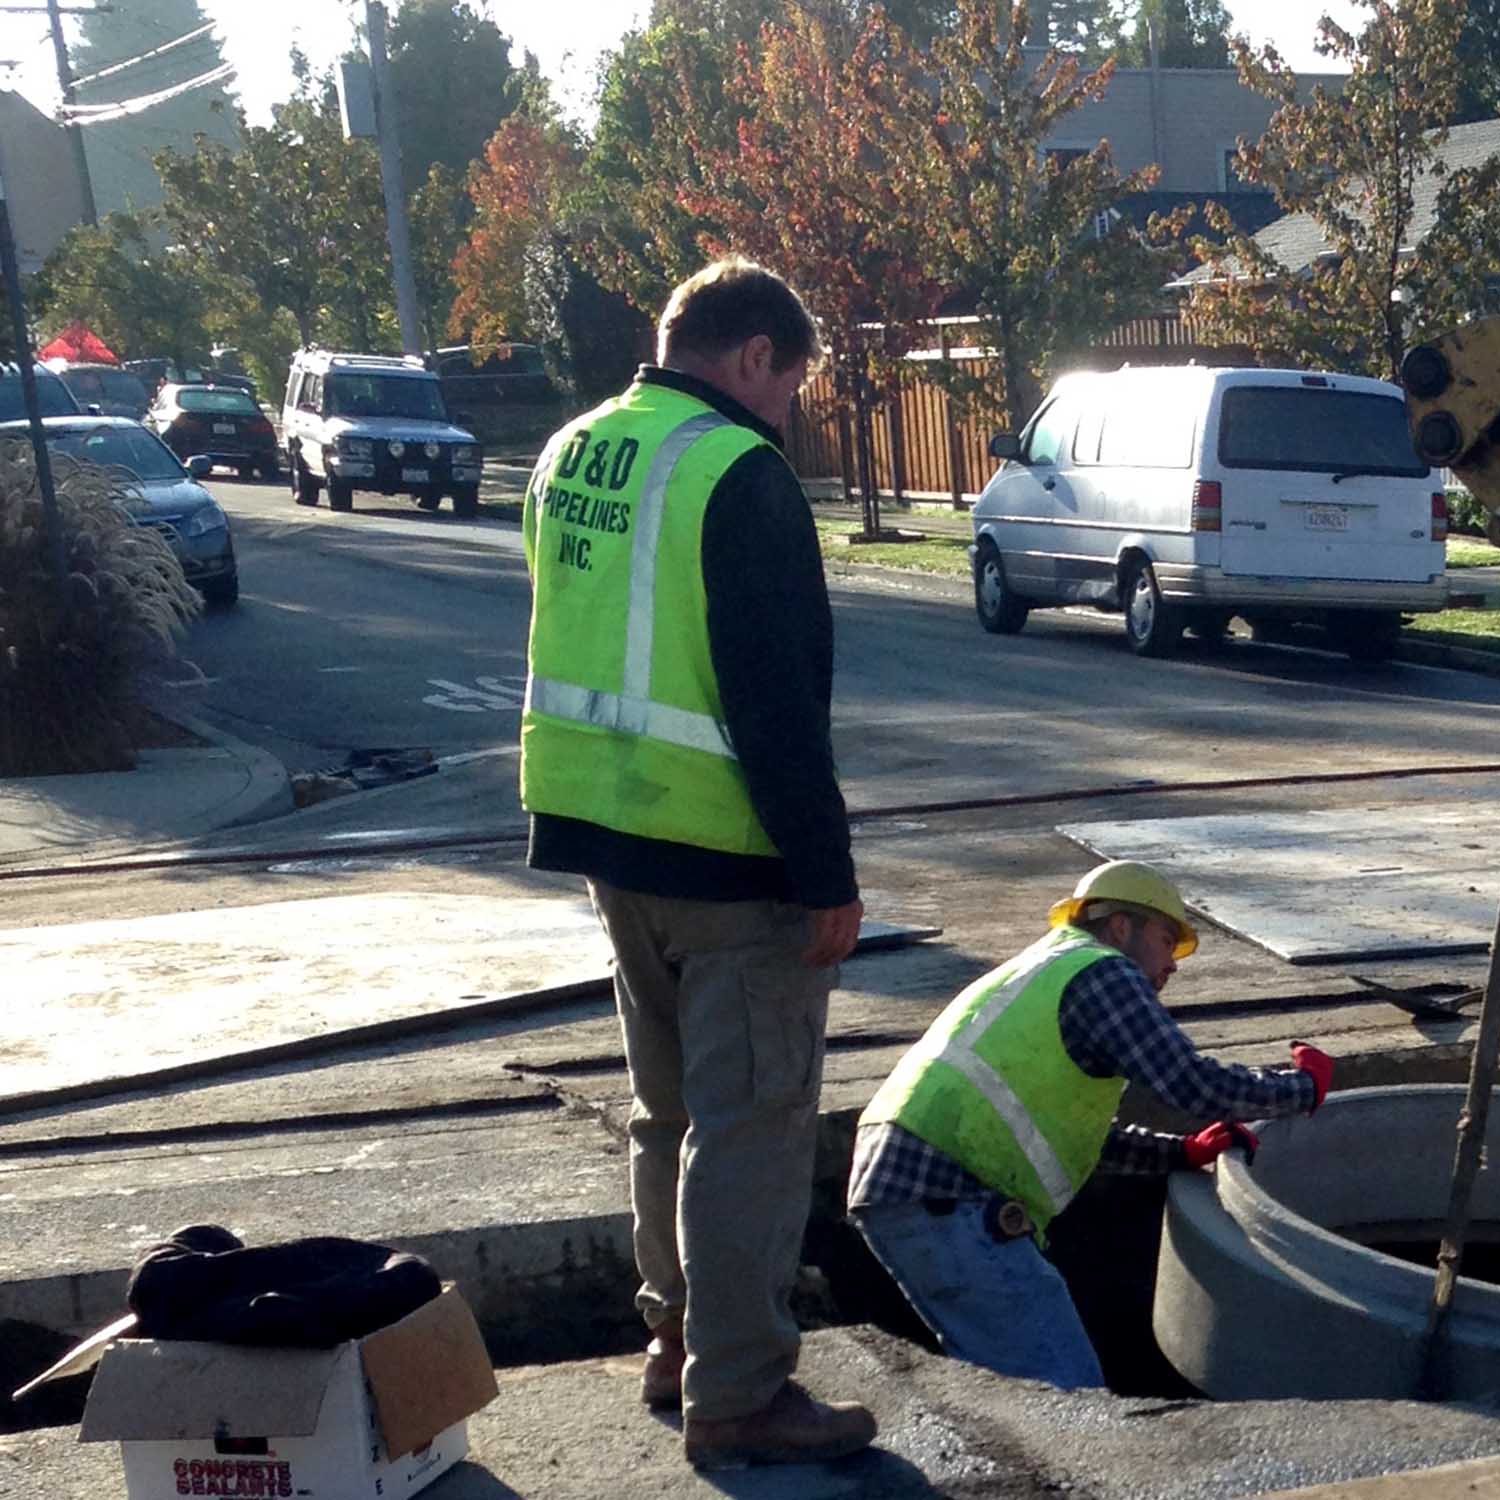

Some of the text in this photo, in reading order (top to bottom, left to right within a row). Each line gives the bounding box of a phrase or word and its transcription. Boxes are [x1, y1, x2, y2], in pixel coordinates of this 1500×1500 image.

[557, 429, 640, 491] D&D
[543, 485, 630, 535] PIPELINES
[558, 532, 592, 571] INC.
[173, 1458, 292, 1479] CONCRETE
[176, 1477, 294, 1497] SEALANTS
